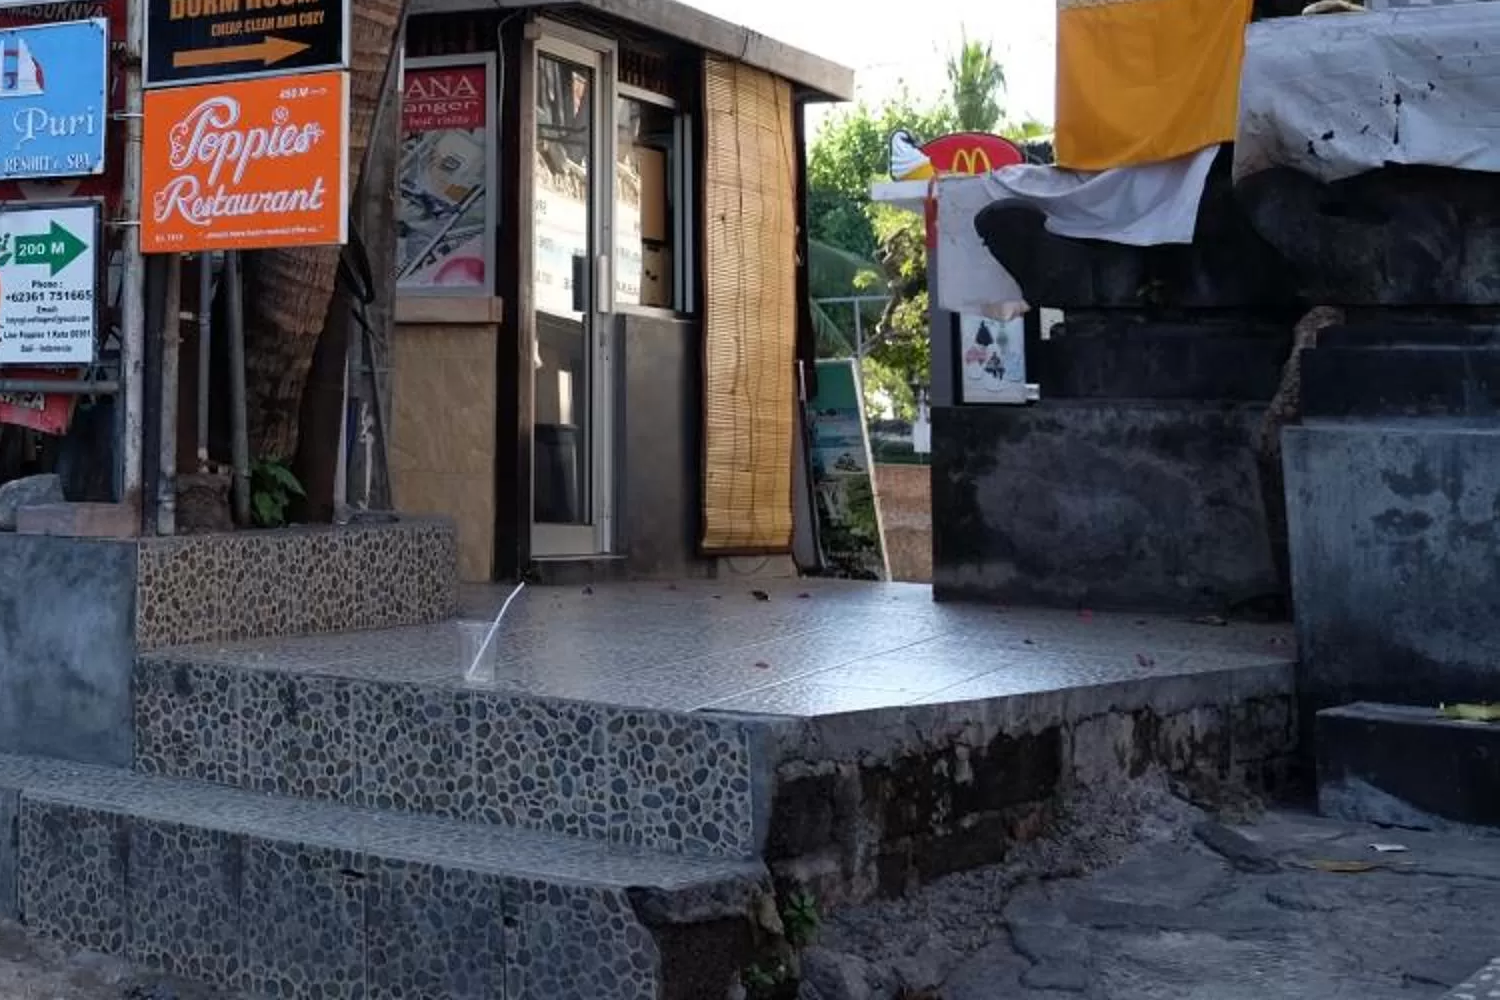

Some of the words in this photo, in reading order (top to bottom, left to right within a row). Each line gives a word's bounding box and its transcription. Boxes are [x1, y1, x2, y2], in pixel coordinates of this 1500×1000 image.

[13, 105, 96, 150] Puri
[169, 95, 324, 186] Poppies
[67, 152, 92, 170] SPA
[154, 175, 327, 226] Restaurant
[18, 243, 45, 257] 200
[51, 241, 65, 255] M
